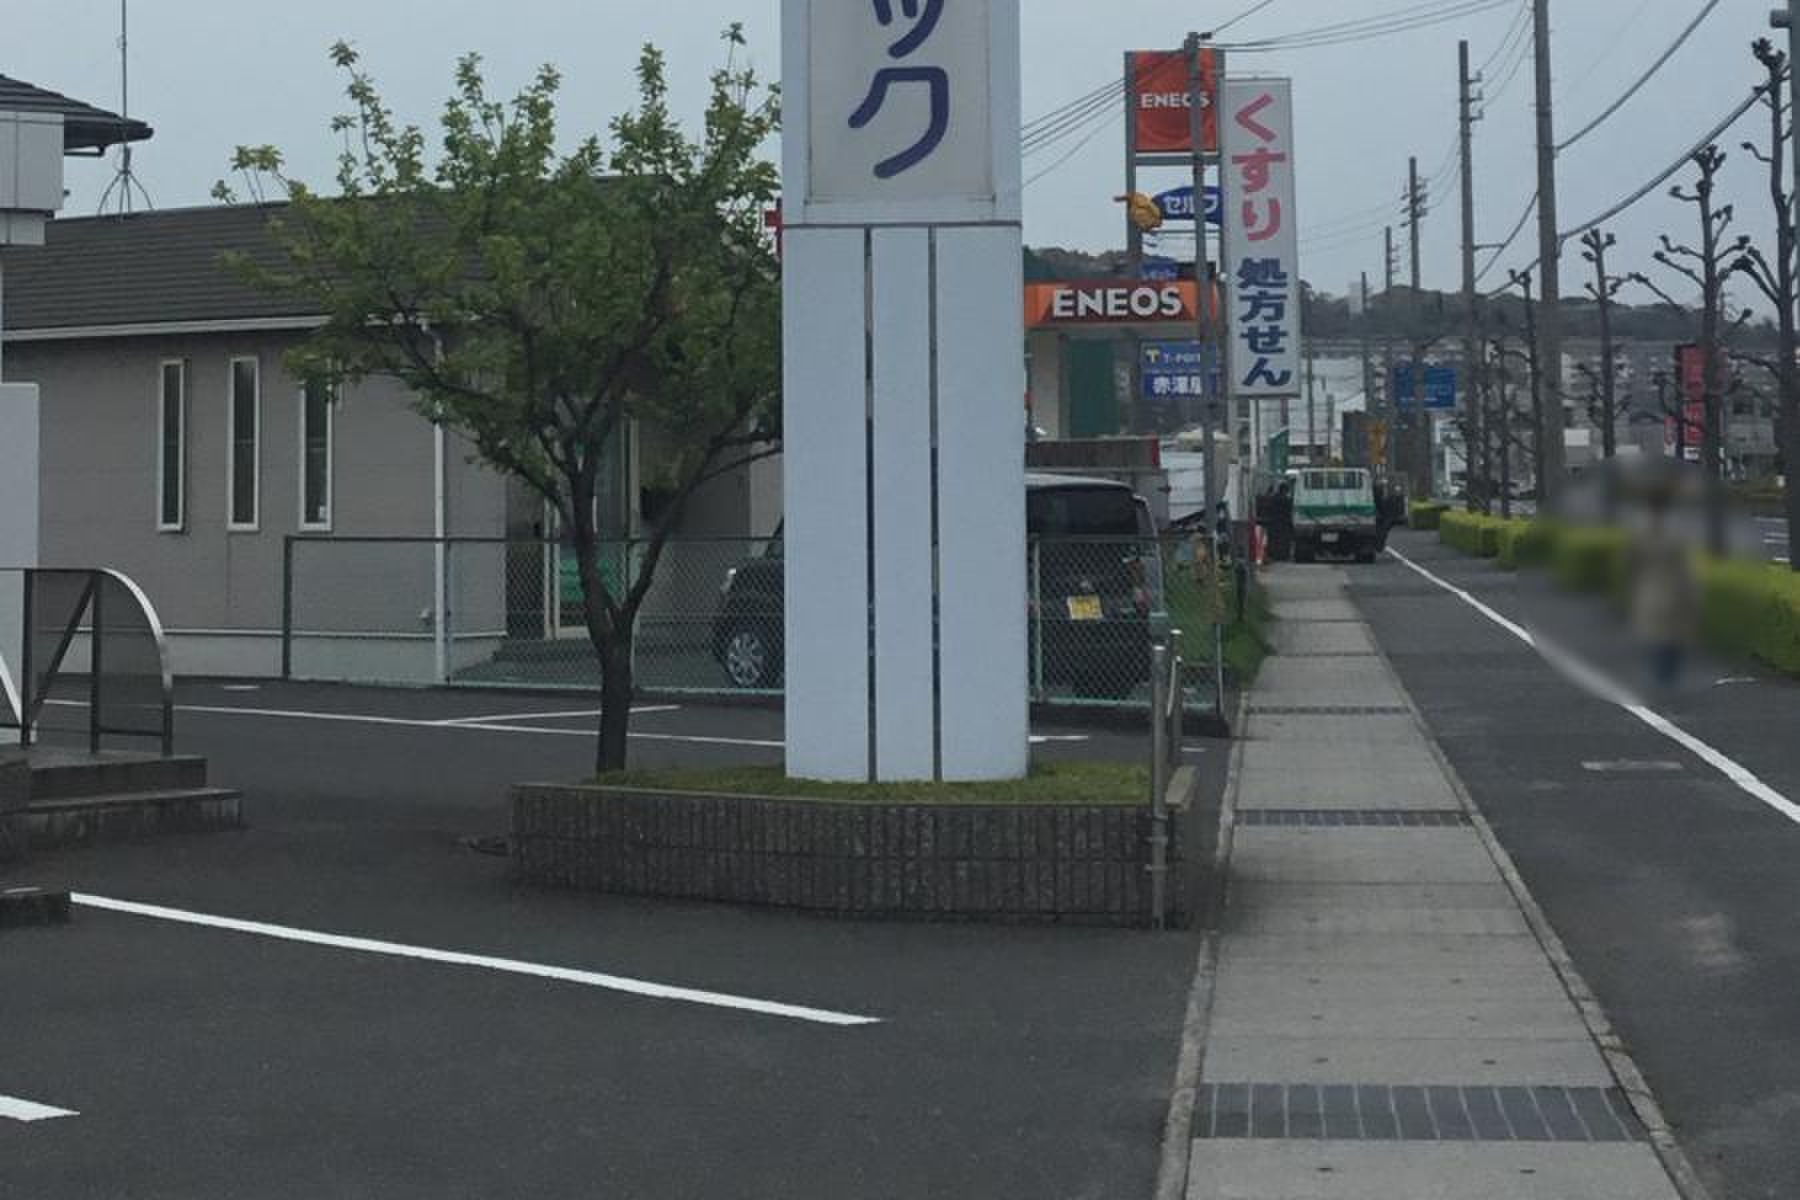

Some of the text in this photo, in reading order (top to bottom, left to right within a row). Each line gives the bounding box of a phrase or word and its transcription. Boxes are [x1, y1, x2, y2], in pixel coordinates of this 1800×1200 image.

[1231, 93, 1287, 241] くすり
[1053, 287, 1183, 318] ENEOS
[1237, 257, 1291, 387] 処方せん
